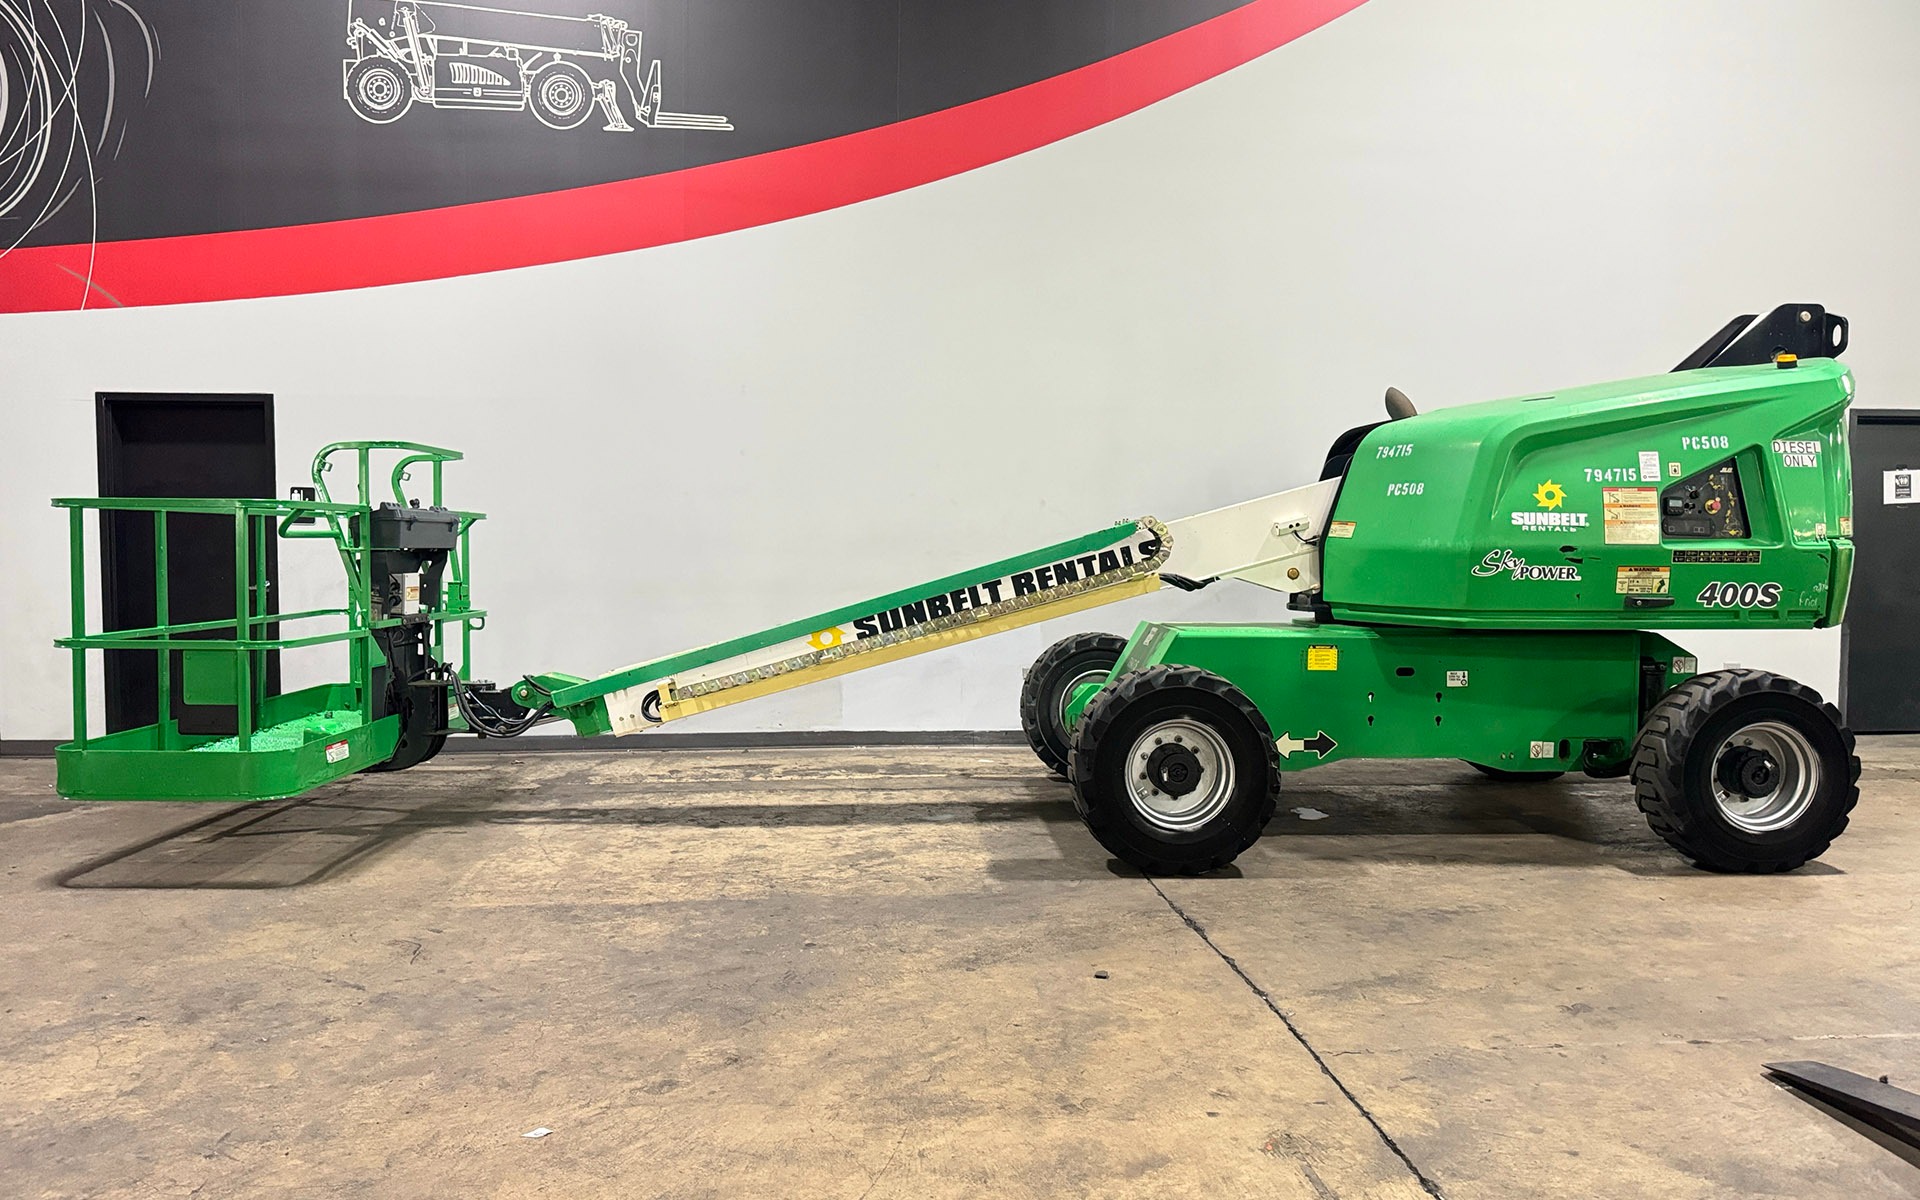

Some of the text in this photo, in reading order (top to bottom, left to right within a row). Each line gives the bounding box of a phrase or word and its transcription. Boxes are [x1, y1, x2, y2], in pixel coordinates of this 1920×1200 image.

[1682, 435, 1729, 450] PC508
[1772, 441, 1821, 454] DIESEL
[1376, 443, 1414, 459] 794715
[1784, 454, 1816, 467] ONLY
[1584, 468, 1637, 482] 794715
[1386, 482, 1425, 496] PC508
[1511, 512, 1588, 527] SUNBELT
[1522, 525, 1577, 533] RENTALS
[1696, 581, 1783, 609] 400S
[853, 578, 1002, 640] SUNBELT
